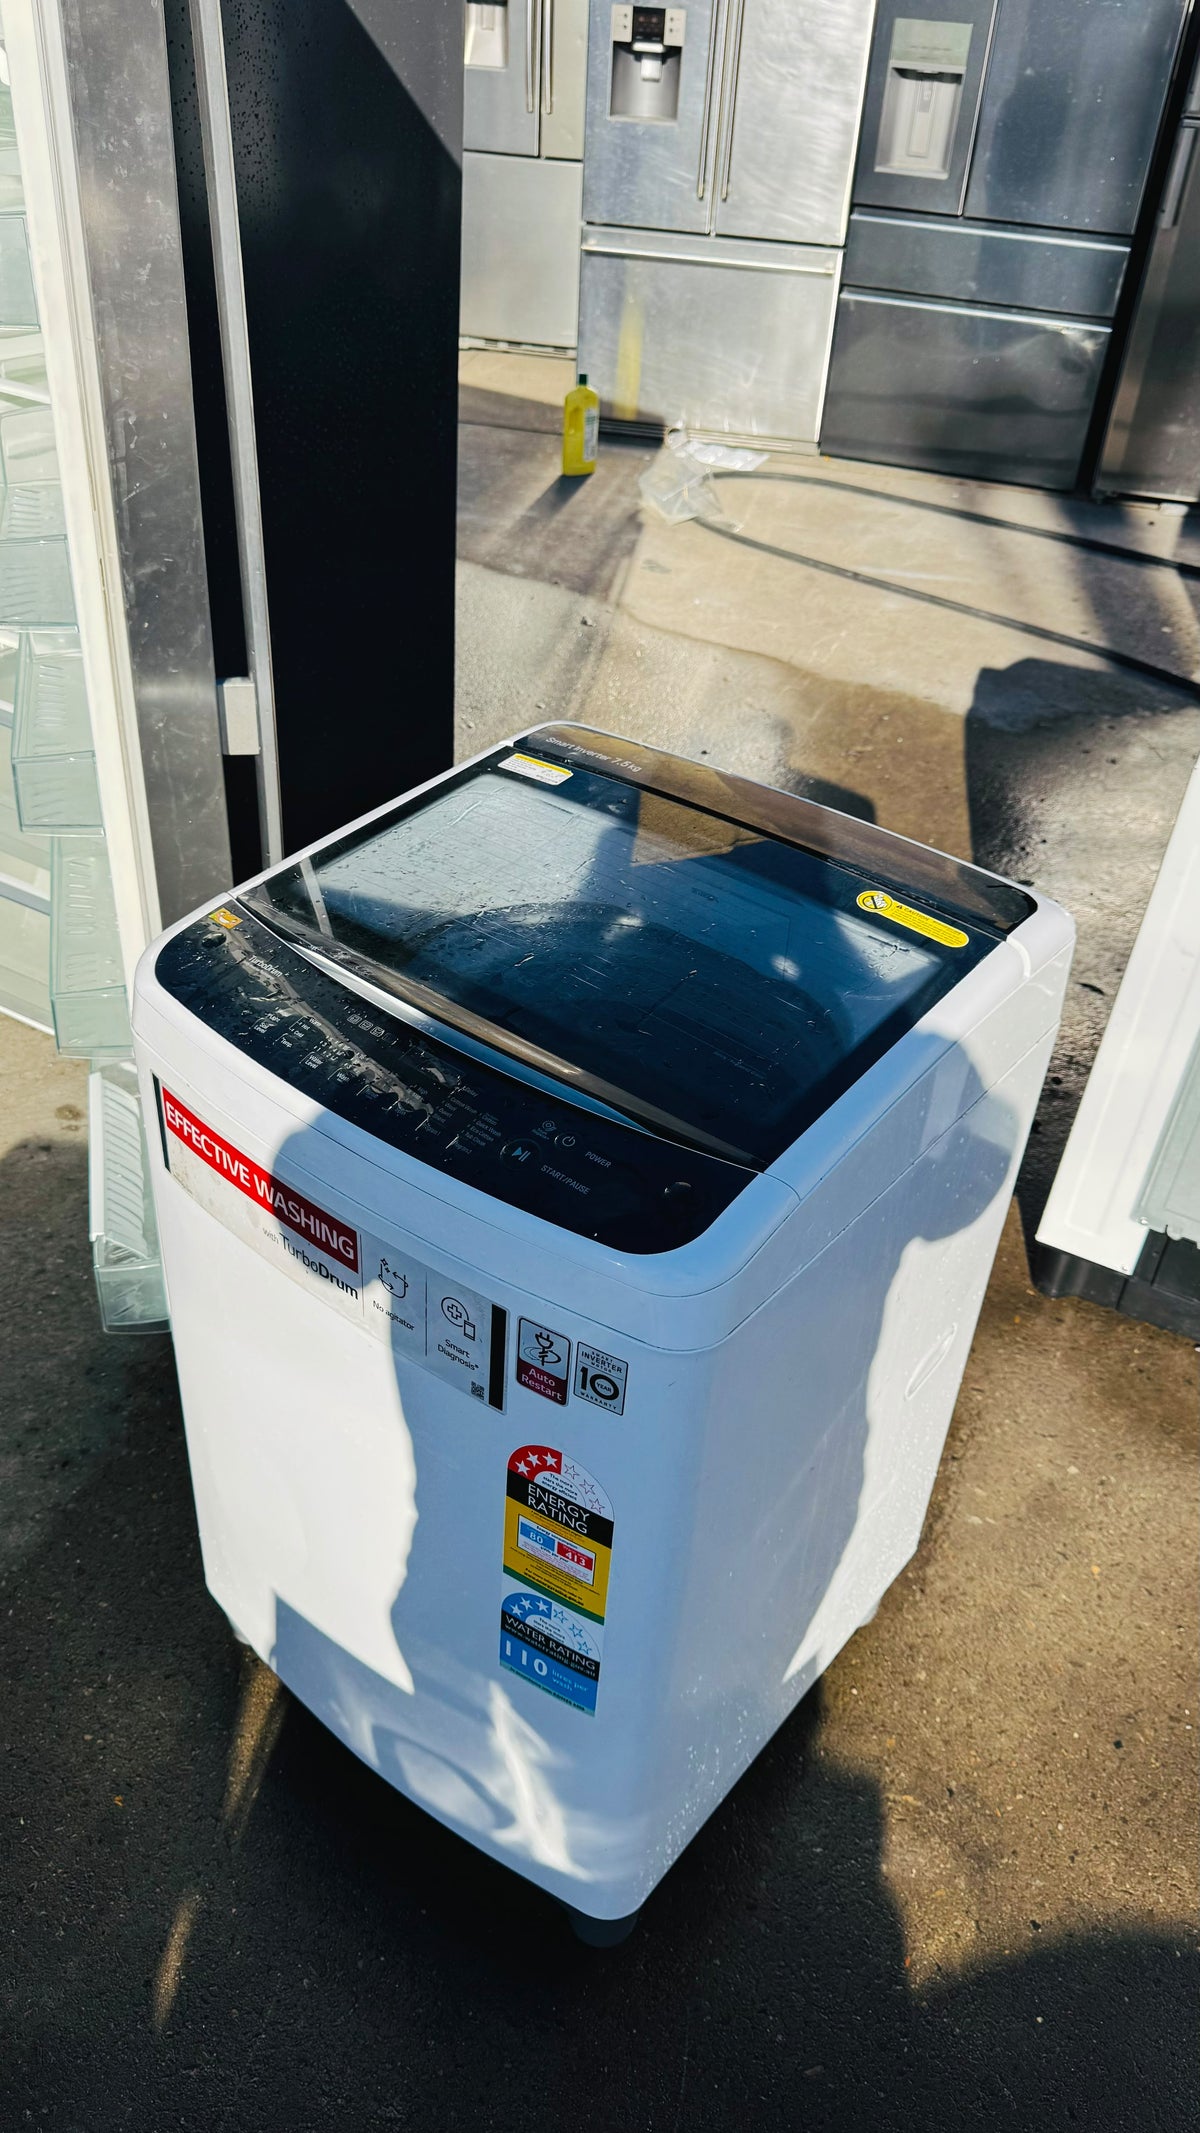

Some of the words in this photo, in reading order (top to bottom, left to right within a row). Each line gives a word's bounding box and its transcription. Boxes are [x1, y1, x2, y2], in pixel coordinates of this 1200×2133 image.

[545, 737, 576, 750] Smart
[576, 744, 611, 761] Inverter
[248, 955, 283, 977] TurboDrum
[304, 1060, 319, 1069] Level
[309, 1054, 324, 1065] Water
[585, 1151, 612, 1168] POWER
[166, 1100, 251, 1188] EFFECTIVE
[253, 1173, 355, 1260] WASHING
[540, 1165, 591, 1195] START/PAUSE
[262, 1227, 279, 1244] with
[279, 1232, 358, 1300] TurboDrum
[373, 1300, 384, 1312] No
[385, 1310, 415, 1331] agitator
[445, 1339, 470, 1359] Smart
[591, 1348, 613, 1363] SMART
[581, 1350, 623, 1374] INVERTER
[591, 1361, 612, 1373] MOTOR
[521, 1374, 562, 1401] Restart
[529, 1368, 555, 1387] Auto
[580, 1366, 620, 1401] 10
[596, 1382, 612, 1393] YEAR
[580, 1392, 617, 1410] WARRANTY
[528, 1483, 590, 1522] ENERGY
[528, 1495, 588, 1534] RATING
[529, 1531, 544, 1544] 80
[565, 1551, 586, 1567] 413
[505, 1615, 546, 1645] WATER
[549, 1640, 596, 1670] RATING
[505, 1640, 548, 1676] 110
